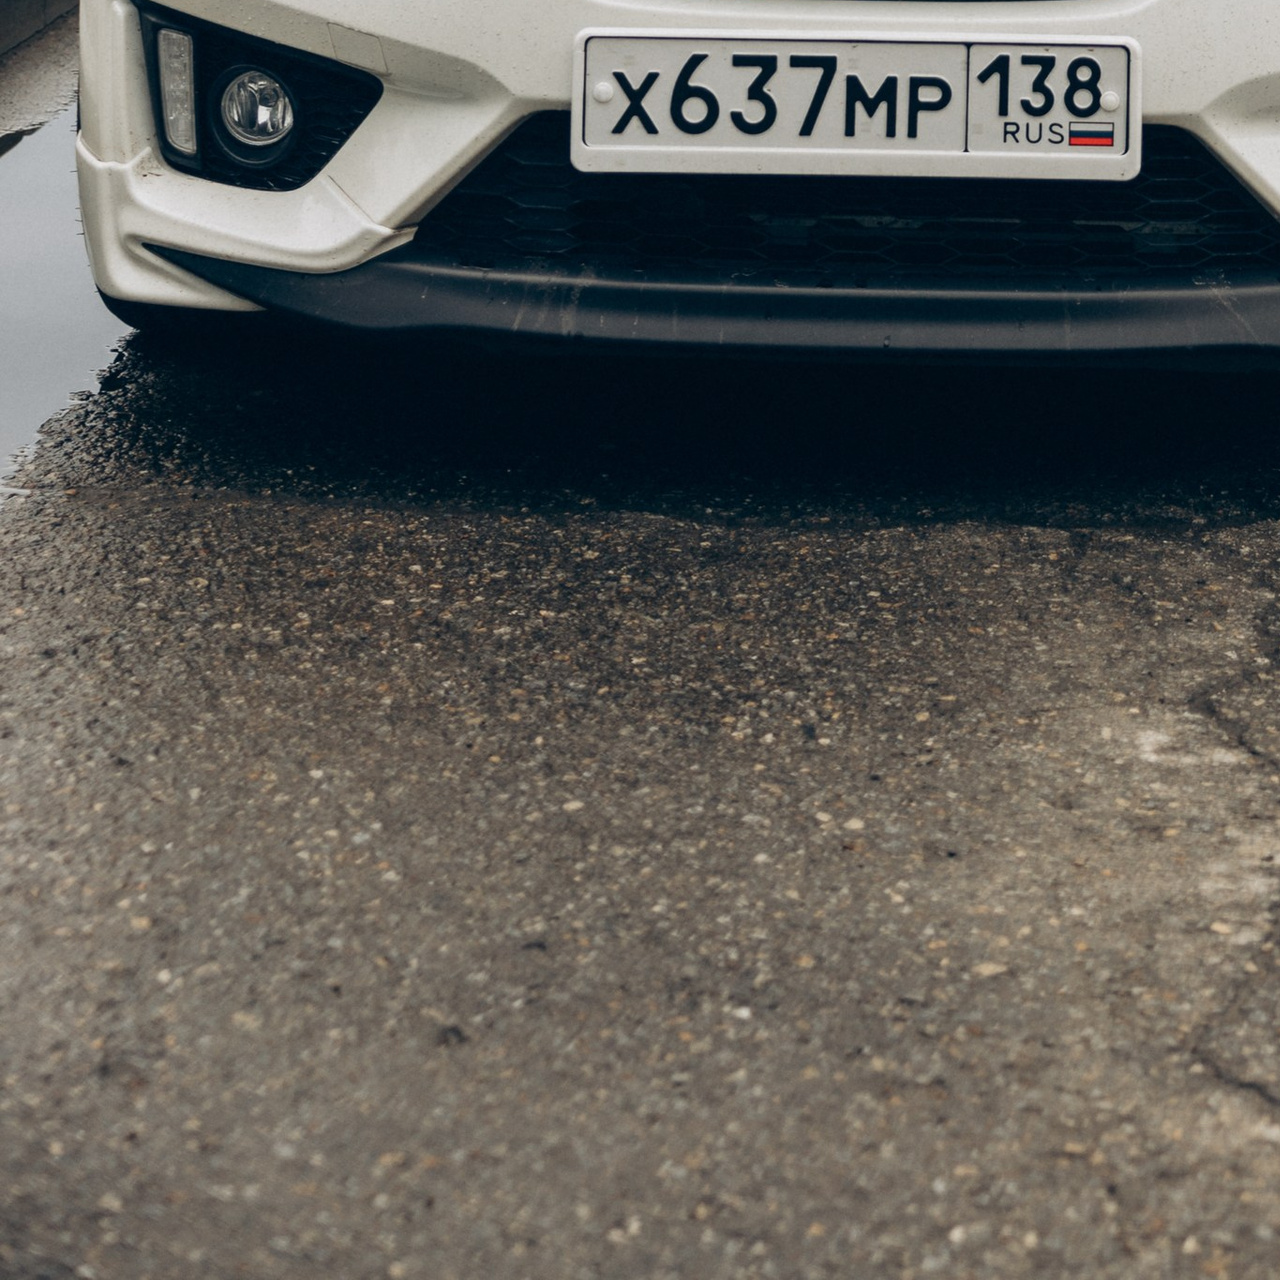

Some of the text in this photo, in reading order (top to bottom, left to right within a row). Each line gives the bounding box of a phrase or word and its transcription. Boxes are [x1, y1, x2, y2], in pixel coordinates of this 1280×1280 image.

[611, 53, 1103, 139] Х637МР 138
[1002, 122, 1065, 145] RUS
